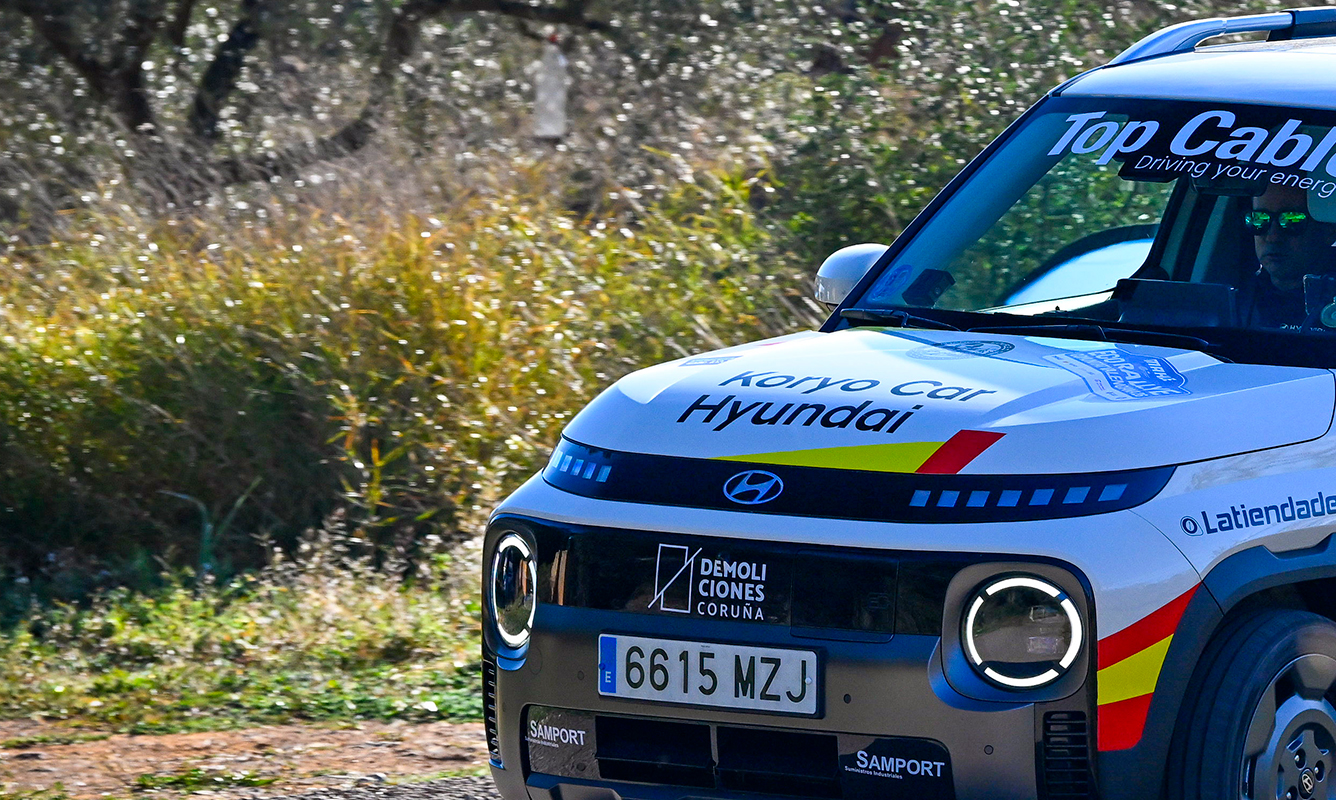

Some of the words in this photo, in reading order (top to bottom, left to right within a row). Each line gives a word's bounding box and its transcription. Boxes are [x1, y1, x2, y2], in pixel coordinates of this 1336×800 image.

[1047, 111, 1159, 166] Top
[1134, 155, 1210, 178] Driving
[1213, 162, 1268, 182] your
[718, 370, 881, 394] Koryo
[889, 379, 999, 402] Car
[676, 394, 924, 433] Hyundai
[700, 558, 767, 581] DEMOLI
[698, 578, 765, 602] CIONES
[697, 601, 764, 620] CORUÑA
[604, 670, 612, 683] E
[625, 645, 718, 696] 6615
[733, 654, 807, 702] MZJ
[530, 719, 586, 746] SAMPORT
[856, 750, 945, 777] SAMPORT
